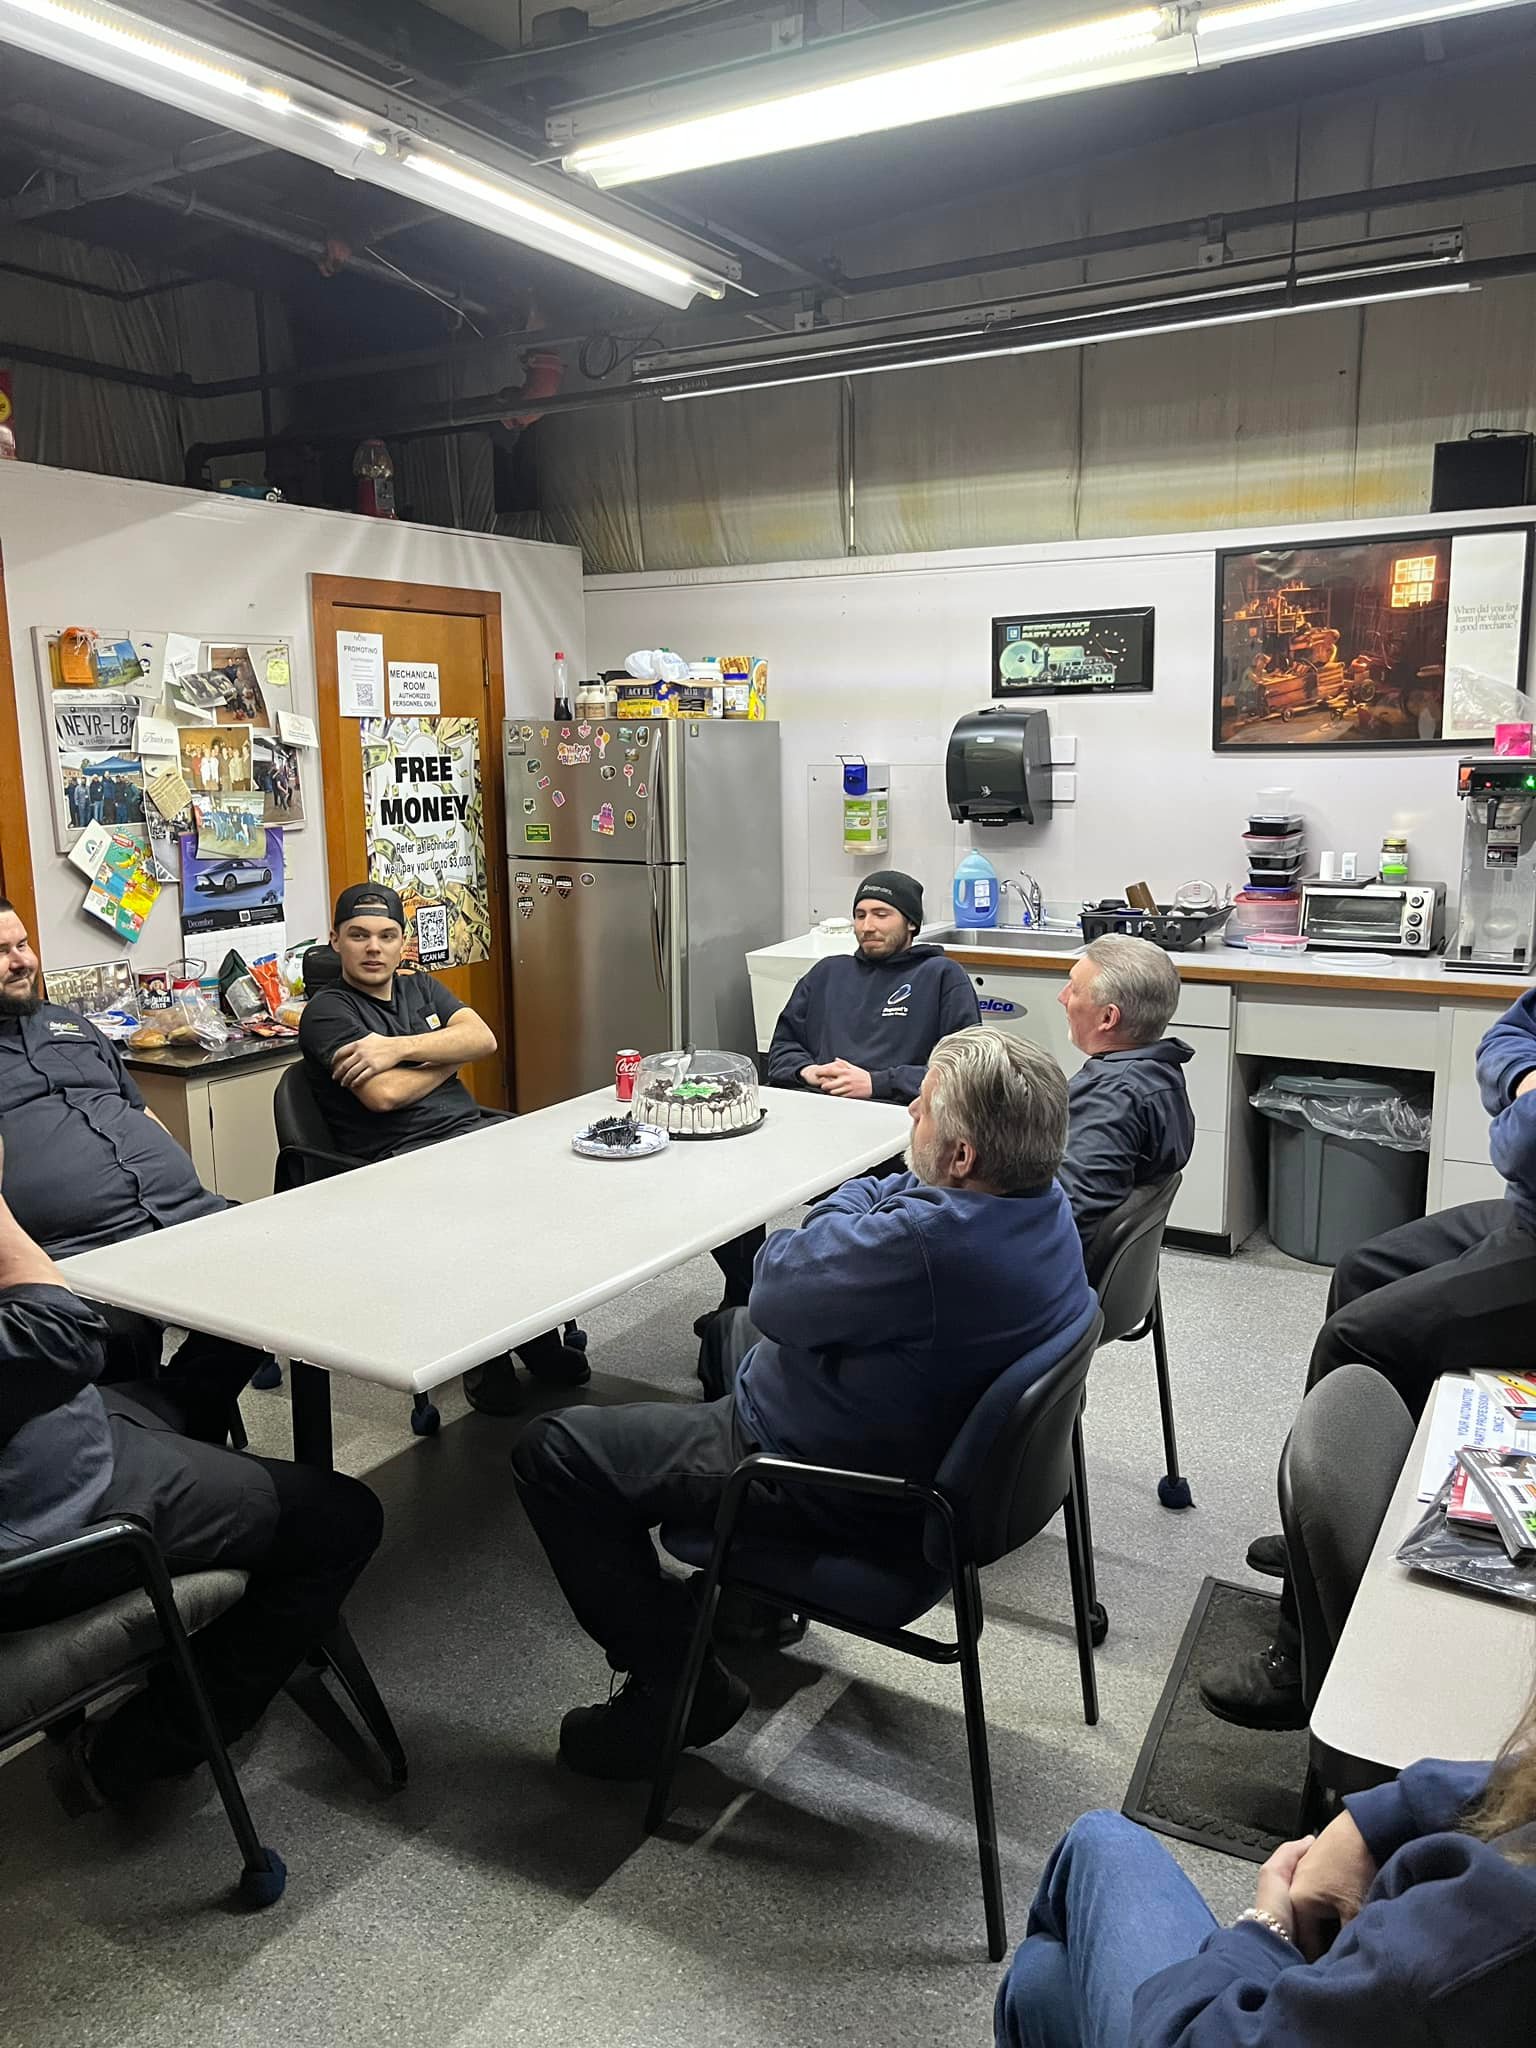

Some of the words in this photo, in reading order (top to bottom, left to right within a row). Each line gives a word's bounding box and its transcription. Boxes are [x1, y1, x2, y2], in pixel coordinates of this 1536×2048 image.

[343, 645, 378, 655] PROMOTING
[389, 669, 437, 680] MECHANICAL
[403, 681, 426, 691] ROOM
[394, 756, 453, 783] FREE
[380, 794, 469, 826] MONEY
[396, 842, 415, 854] Refer
[423, 840, 458, 852] Technician
[402, 864, 415, 876] pay
[416, 862, 429, 874] you
[431, 860, 439, 872] up
[440, 859, 448, 869] to
[187, 918, 214, 929] December
[421, 953, 436, 963] SCAN
[437, 951, 447, 960] ME
[1460, 1387, 1474, 1420] AUTOMOTIVE
[1457, 1420, 1470, 1436] YOUR
[1492, 1416, 1505, 1433] SINCE
[1473, 1427, 1486, 1446] PARTS
